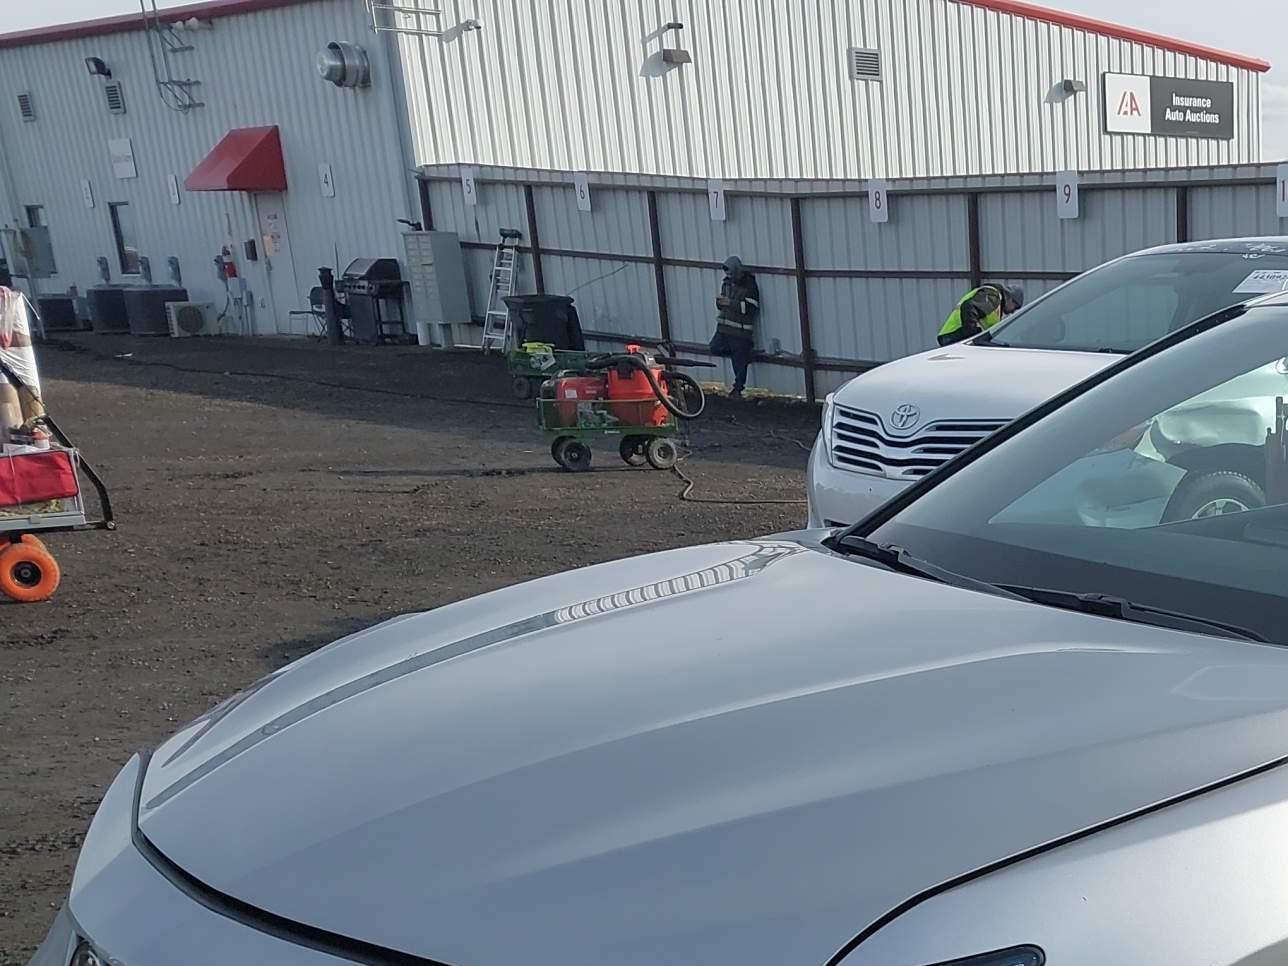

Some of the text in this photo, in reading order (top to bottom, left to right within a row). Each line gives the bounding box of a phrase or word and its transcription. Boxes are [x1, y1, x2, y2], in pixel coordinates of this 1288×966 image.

[1172, 93, 1211, 108] Insurance
[1165, 107, 1219, 123] Auto Auctions
[323, 173, 329, 188] 4
[465, 178, 472, 194] 5
[579, 184, 586, 200] 6
[713, 191, 719, 209] 7
[874, 190, 882, 210] 8
[1063, 183, 1072, 204] 9
